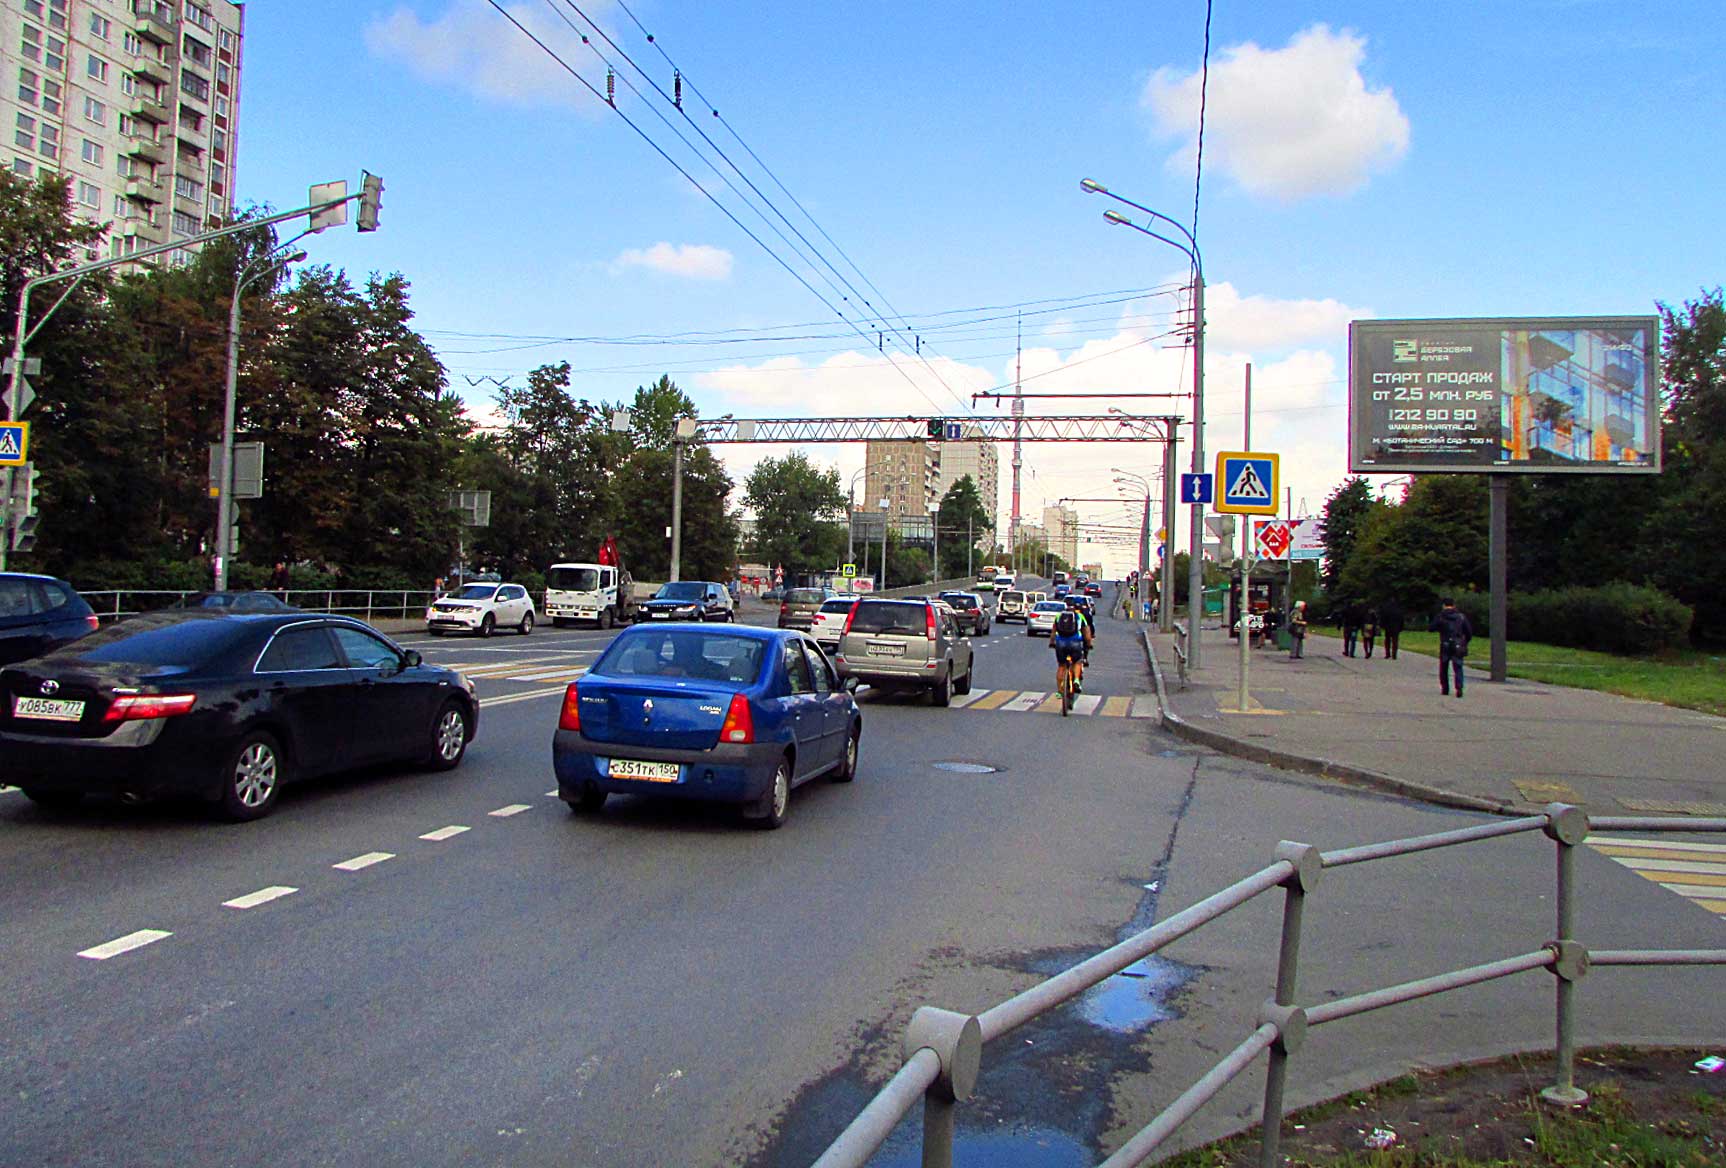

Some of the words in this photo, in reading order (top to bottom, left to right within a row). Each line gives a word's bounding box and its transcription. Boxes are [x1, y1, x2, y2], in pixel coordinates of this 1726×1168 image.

[1372, 372, 1422, 384] СТАРТ
[1426, 372, 1493, 385] ПРОДАЖ
[1372, 390, 1391, 401] ОТ
[1394, 387, 1423, 402] 2,5
[1429, 390, 1462, 401] МЛН.
[1465, 390, 1493, 401] РУБ
[1425, 409, 1449, 421] 90
[1453, 409, 1477, 421] 90
[63, 701, 82, 712] 777
[612, 761, 656, 775] С351ТК
[658, 764, 676, 775] 150
